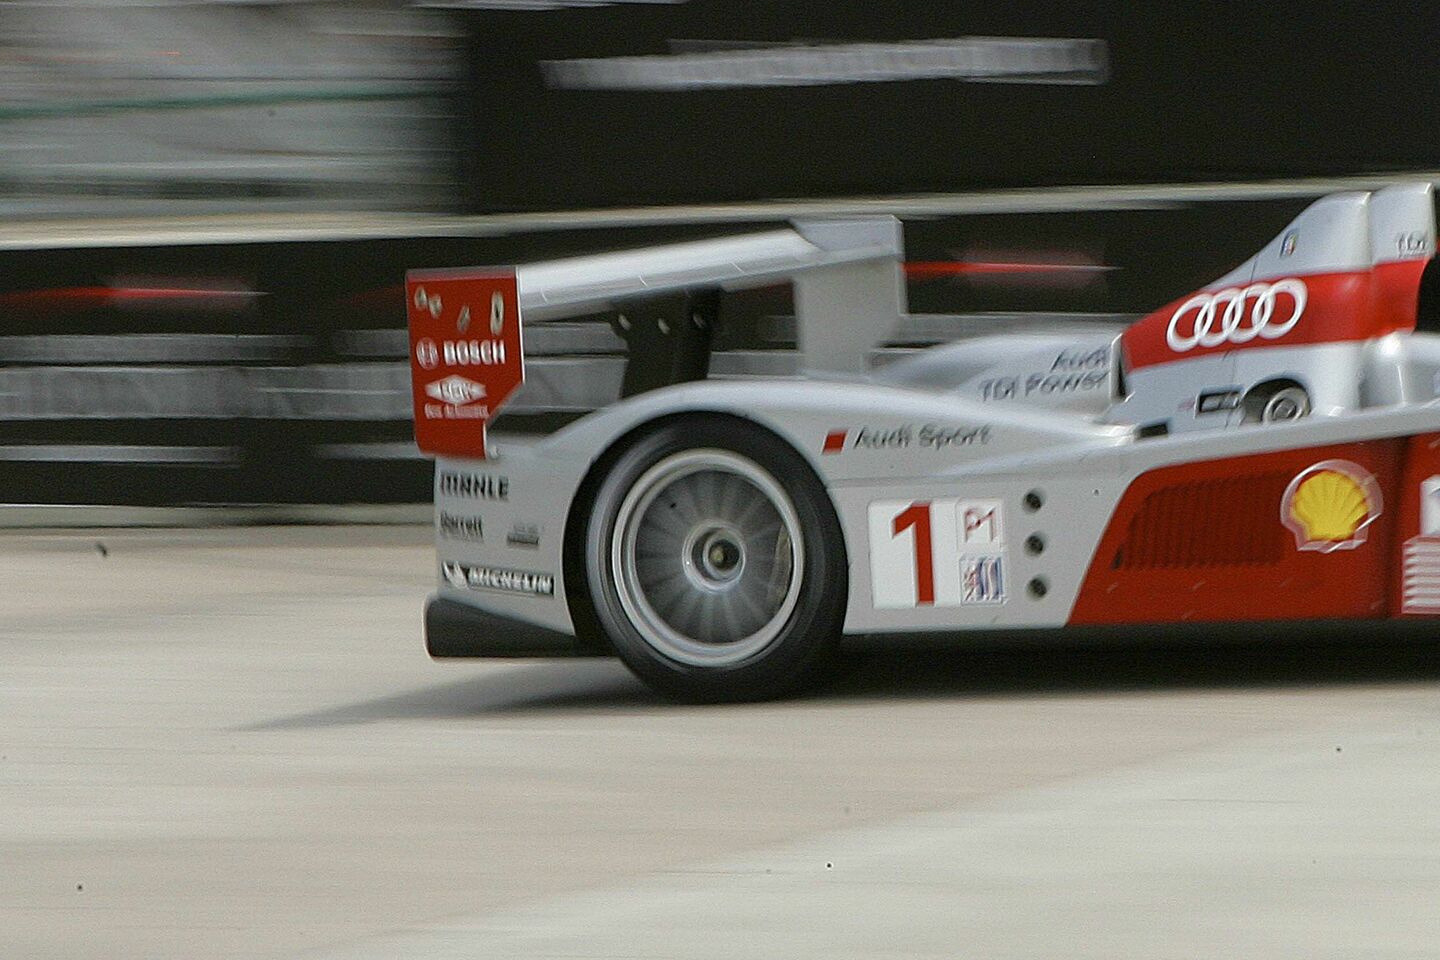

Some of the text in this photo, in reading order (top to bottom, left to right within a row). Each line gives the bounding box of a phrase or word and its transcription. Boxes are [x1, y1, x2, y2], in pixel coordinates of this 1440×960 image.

[443, 339, 506, 366] BOSCH
[853, 422, 993, 450] Audi Sport
[892, 501, 935, 607] 1
